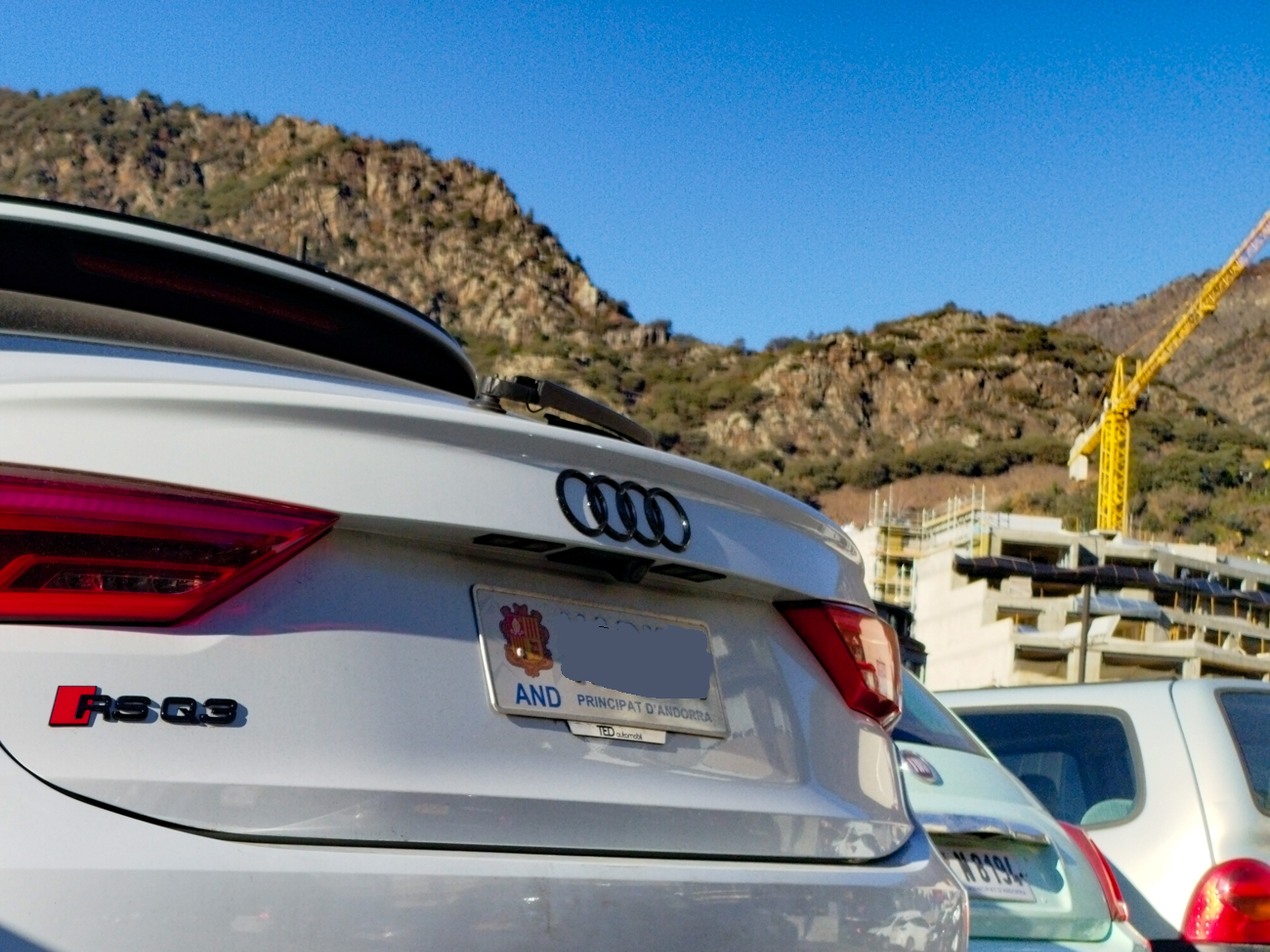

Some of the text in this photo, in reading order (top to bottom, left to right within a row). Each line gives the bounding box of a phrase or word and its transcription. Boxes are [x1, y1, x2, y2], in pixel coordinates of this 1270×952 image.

[516, 682, 713, 723] AND PRINCIPAT D'ANDORRA
[596, 725, 615, 737] TED
